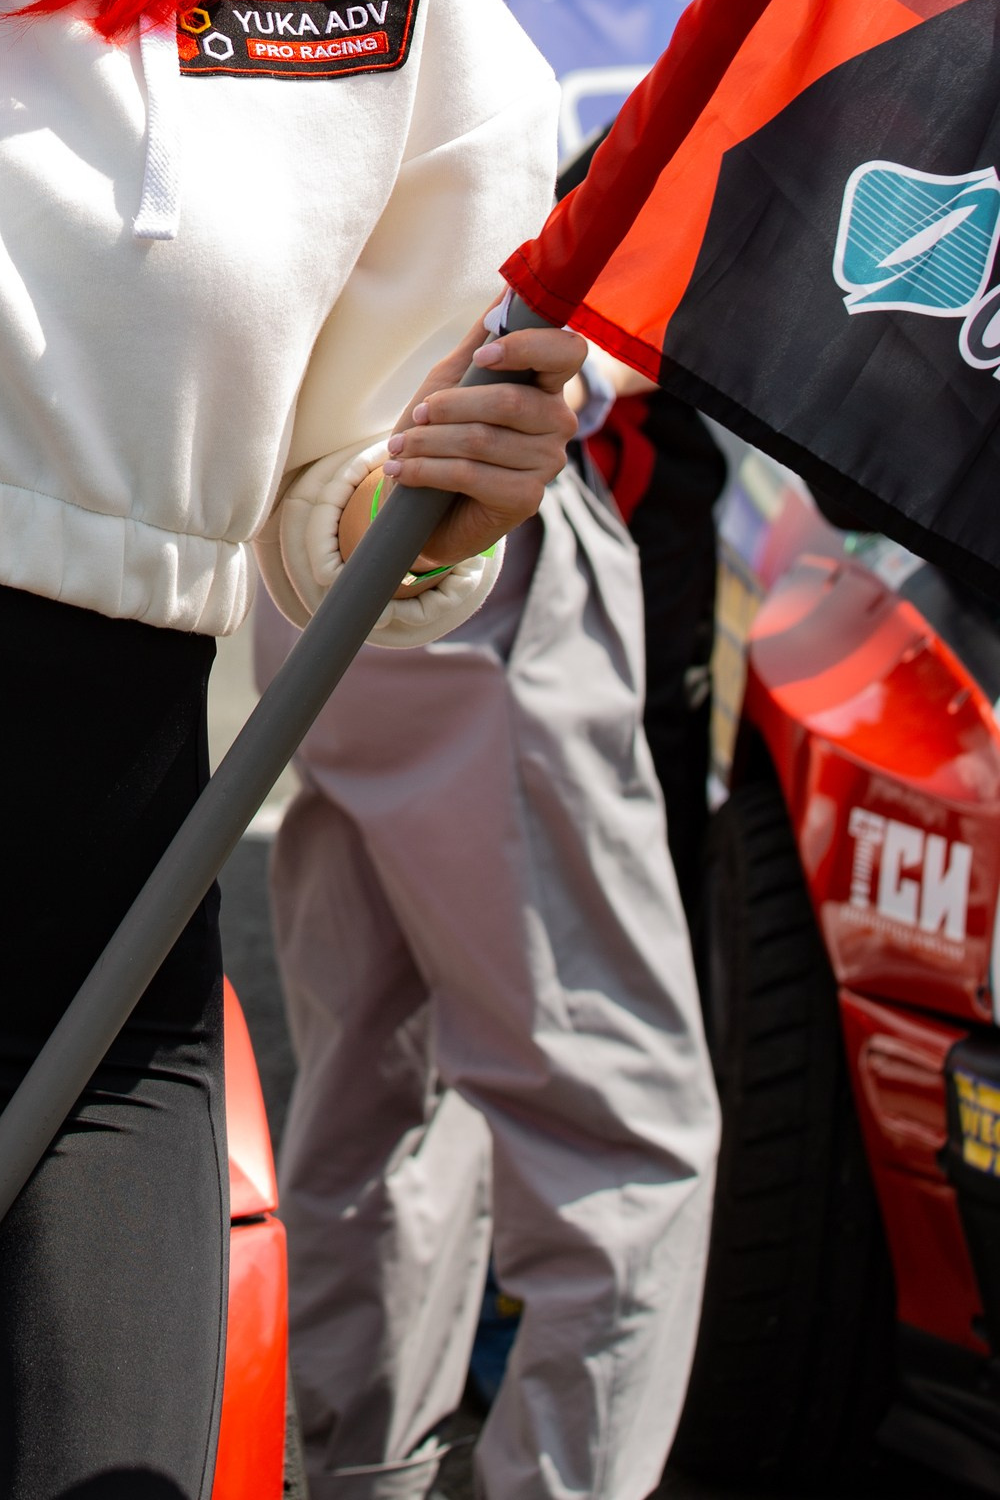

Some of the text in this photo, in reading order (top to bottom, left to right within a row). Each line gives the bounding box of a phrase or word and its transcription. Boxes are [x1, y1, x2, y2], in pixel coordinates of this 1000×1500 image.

[232, 0, 388, 36] YUKA ADV
[255, 37, 378, 59] PRO RACING
